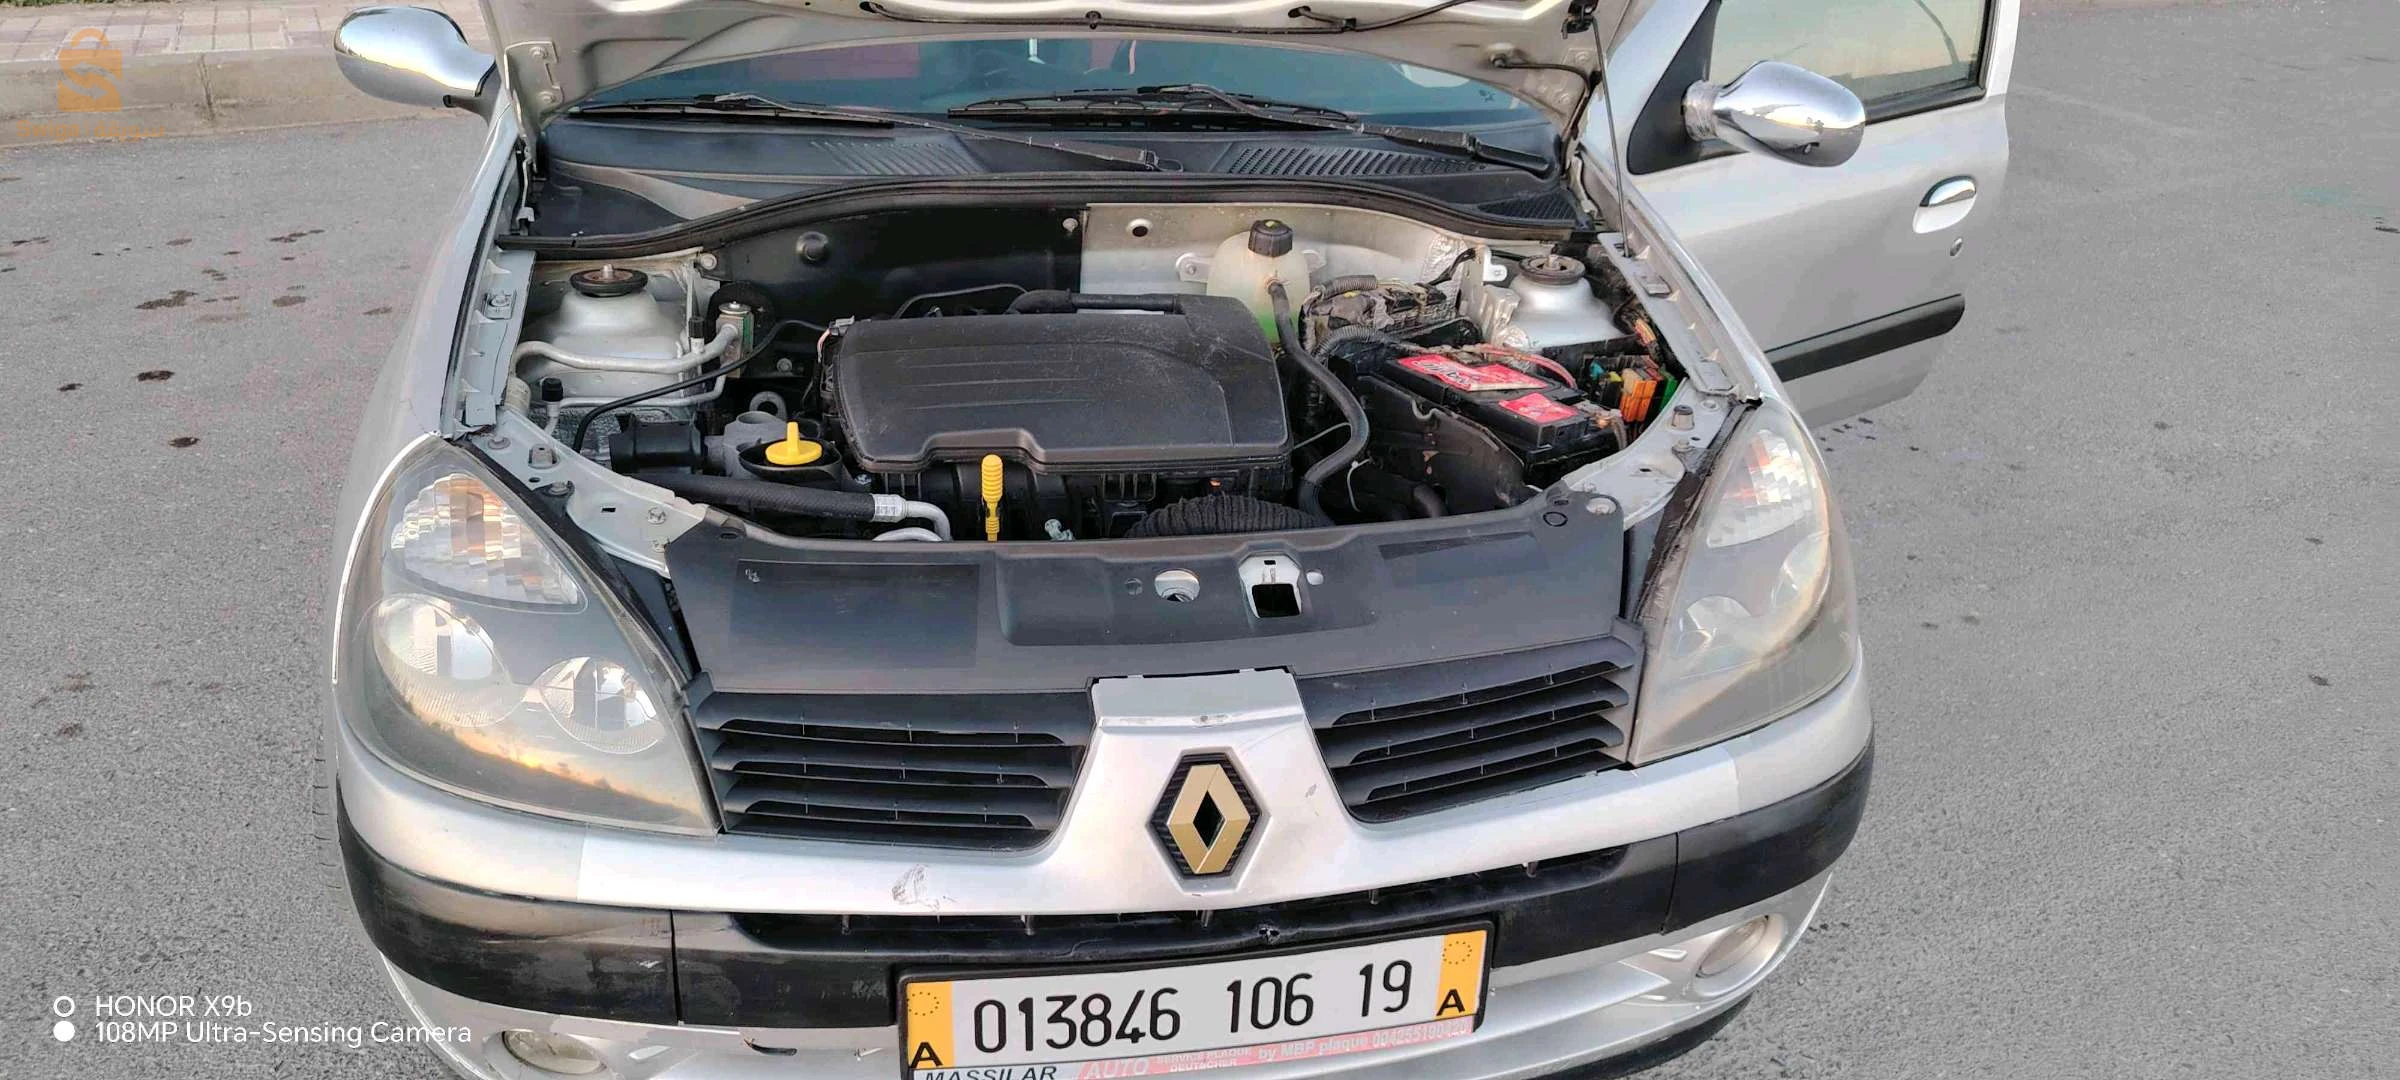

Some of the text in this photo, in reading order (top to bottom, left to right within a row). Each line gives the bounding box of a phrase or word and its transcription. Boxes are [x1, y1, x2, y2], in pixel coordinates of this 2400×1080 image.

[974, 960, 1412, 1053] 013846 106 19
[1436, 988, 1466, 1017] A
[910, 1041, 943, 1068] A
[1258, 1046, 1277, 1061] by
[1085, 1057, 1150, 1079] AUTO
